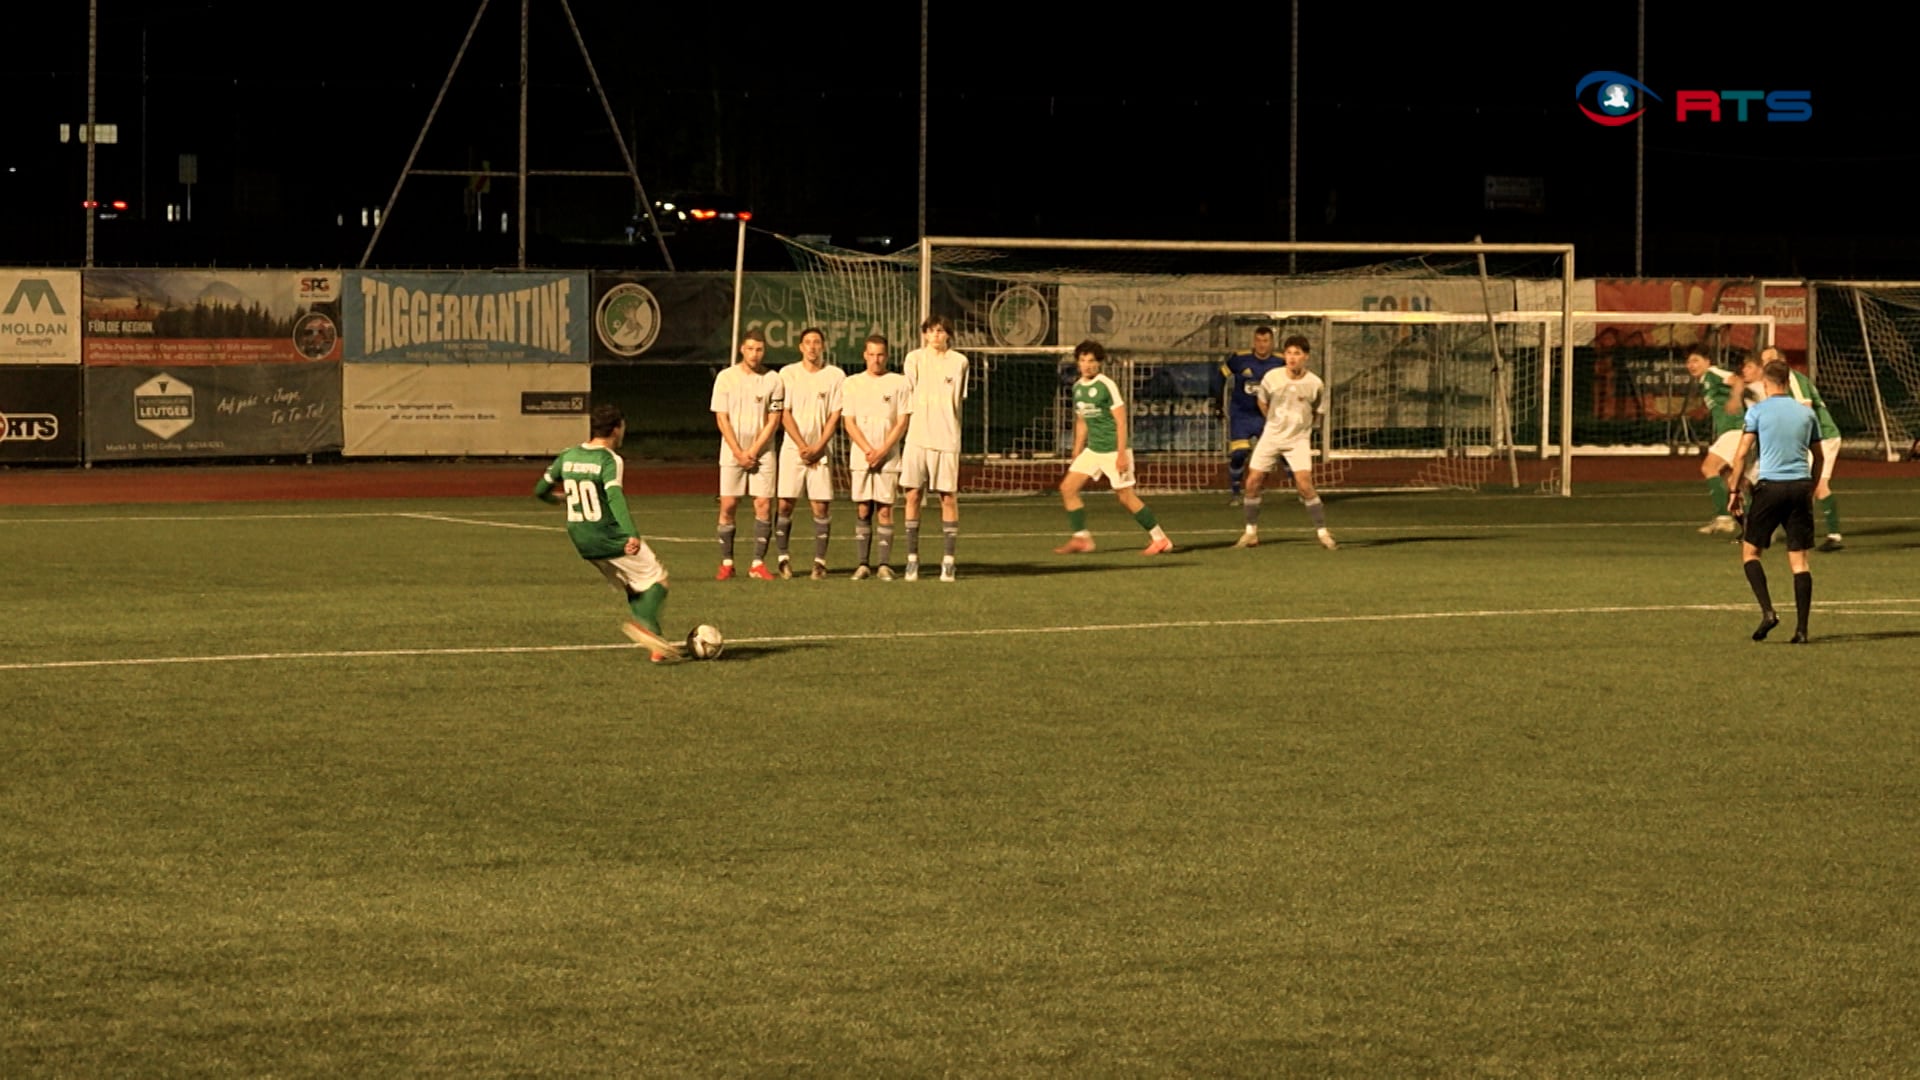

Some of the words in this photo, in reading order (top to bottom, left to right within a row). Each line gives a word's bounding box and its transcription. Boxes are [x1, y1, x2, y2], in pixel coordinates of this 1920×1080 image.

[301, 278, 329, 292] SPG
[361, 276, 571, 355] TAGGERKANTINE
[1, 323, 67, 335] MOLDAN
[88, 319, 106, 333] FÜR
[106, 321, 121, 333] DIE
[140, 405, 189, 418] LEUTGEB
[563, 479, 602, 522] 20
